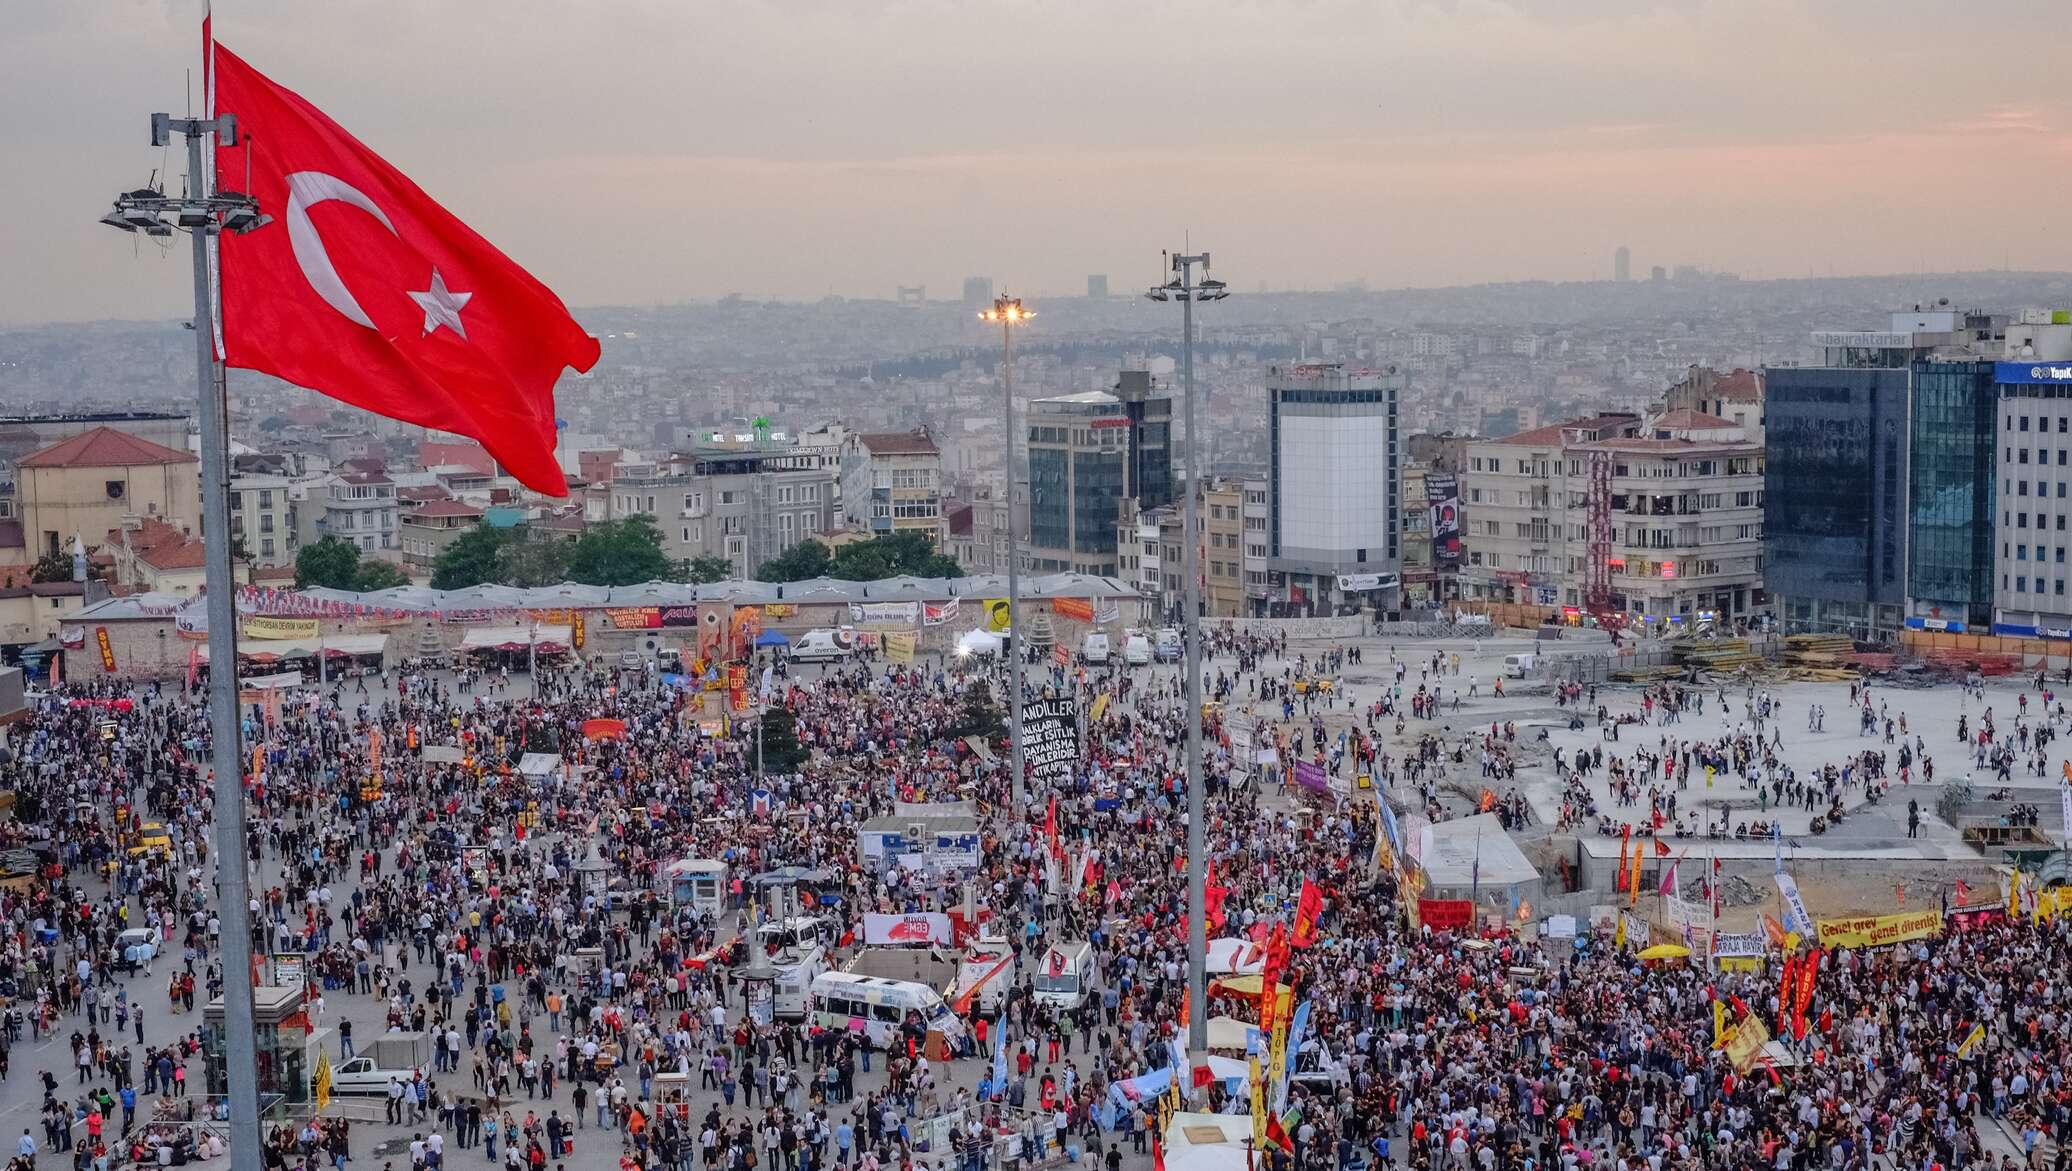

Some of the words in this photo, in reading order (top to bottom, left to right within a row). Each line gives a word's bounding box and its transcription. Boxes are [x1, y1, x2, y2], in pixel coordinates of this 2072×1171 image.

[98, 631, 113, 667] SYKP
[1022, 699, 1074, 721] ANDİLLER
[1821, 920, 1851, 937] Genel
[1853, 918, 1877, 935] grev
[1870, 923, 1899, 943] genel
[1262, 989, 1273, 1029] DHF
